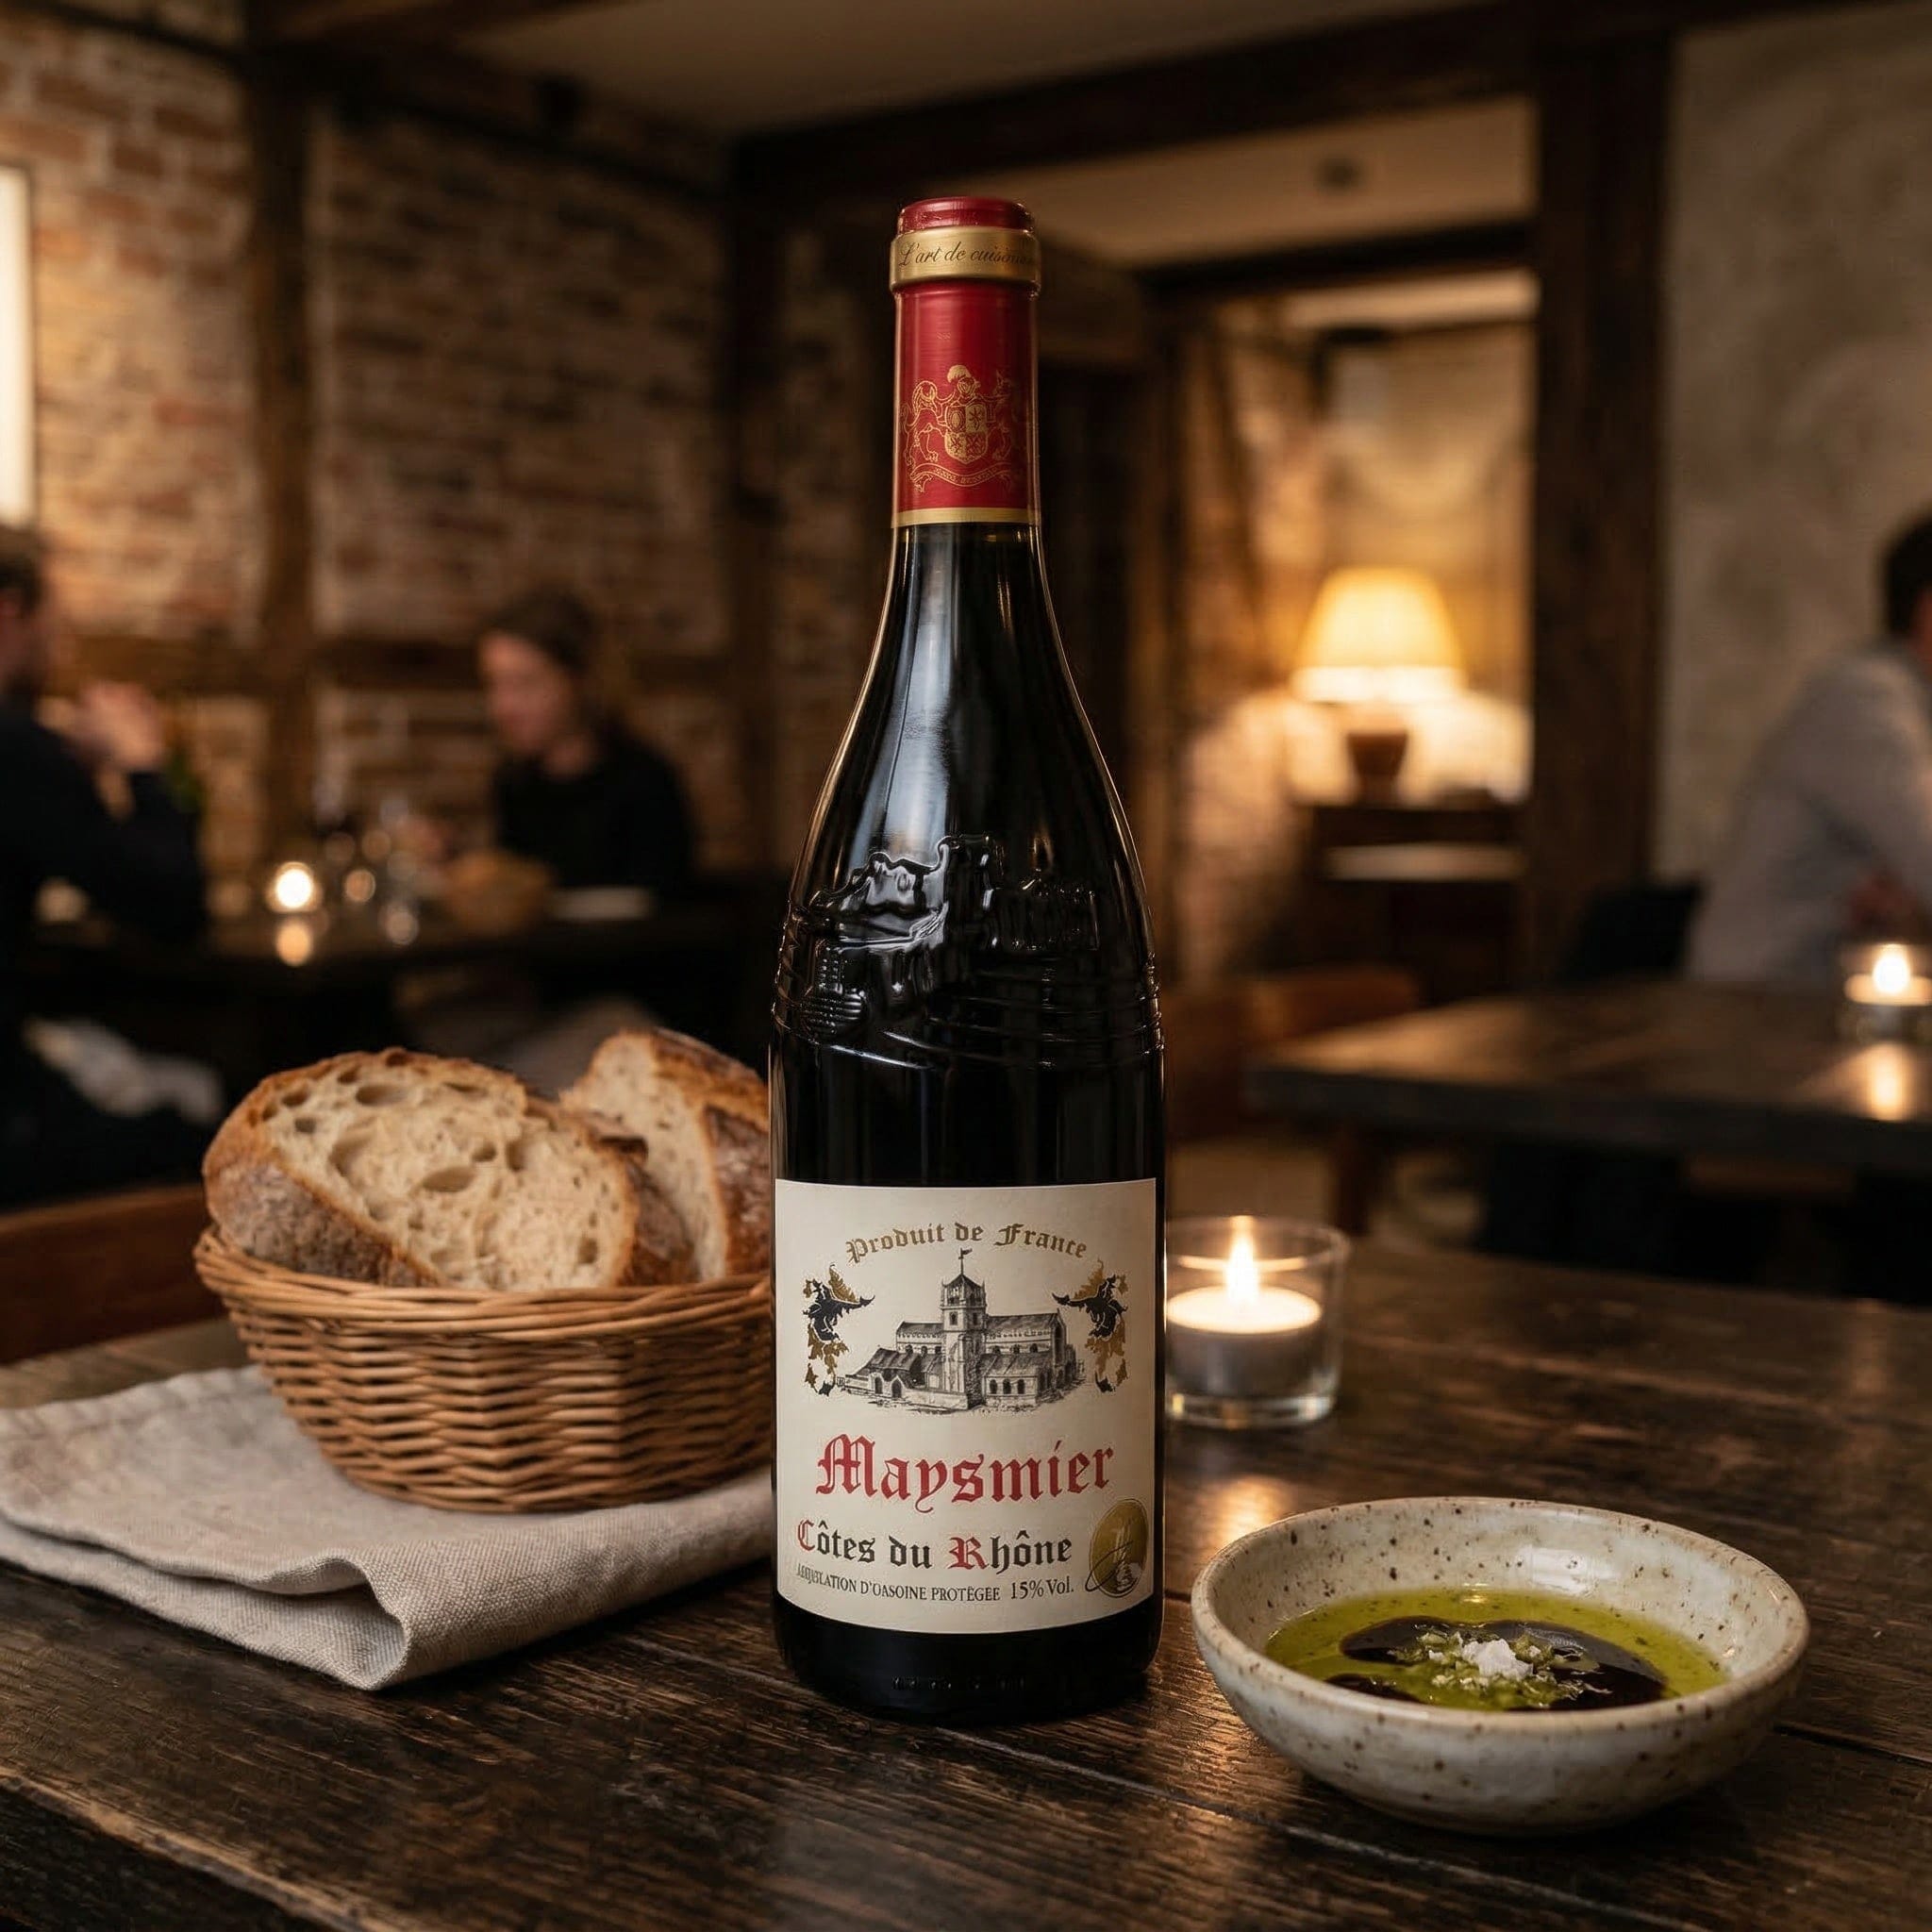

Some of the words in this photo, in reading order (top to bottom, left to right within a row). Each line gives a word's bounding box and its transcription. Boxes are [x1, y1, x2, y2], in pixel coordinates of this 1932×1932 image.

[944, 242, 967, 261] de
[845, 1224, 944, 1263] Produit
[955, 1223, 984, 1241] de
[993, 1223, 1088, 1258] France
[815, 1433, 1114, 1513] Maysmier
[796, 1519, 875, 1563] Côtes
[889, 1534, 932, 1569] du
[948, 1530, 1073, 1574] Rhône
[1010, 1579, 1044, 1600] 15%
[1045, 1575, 1074, 1596] Vol.
